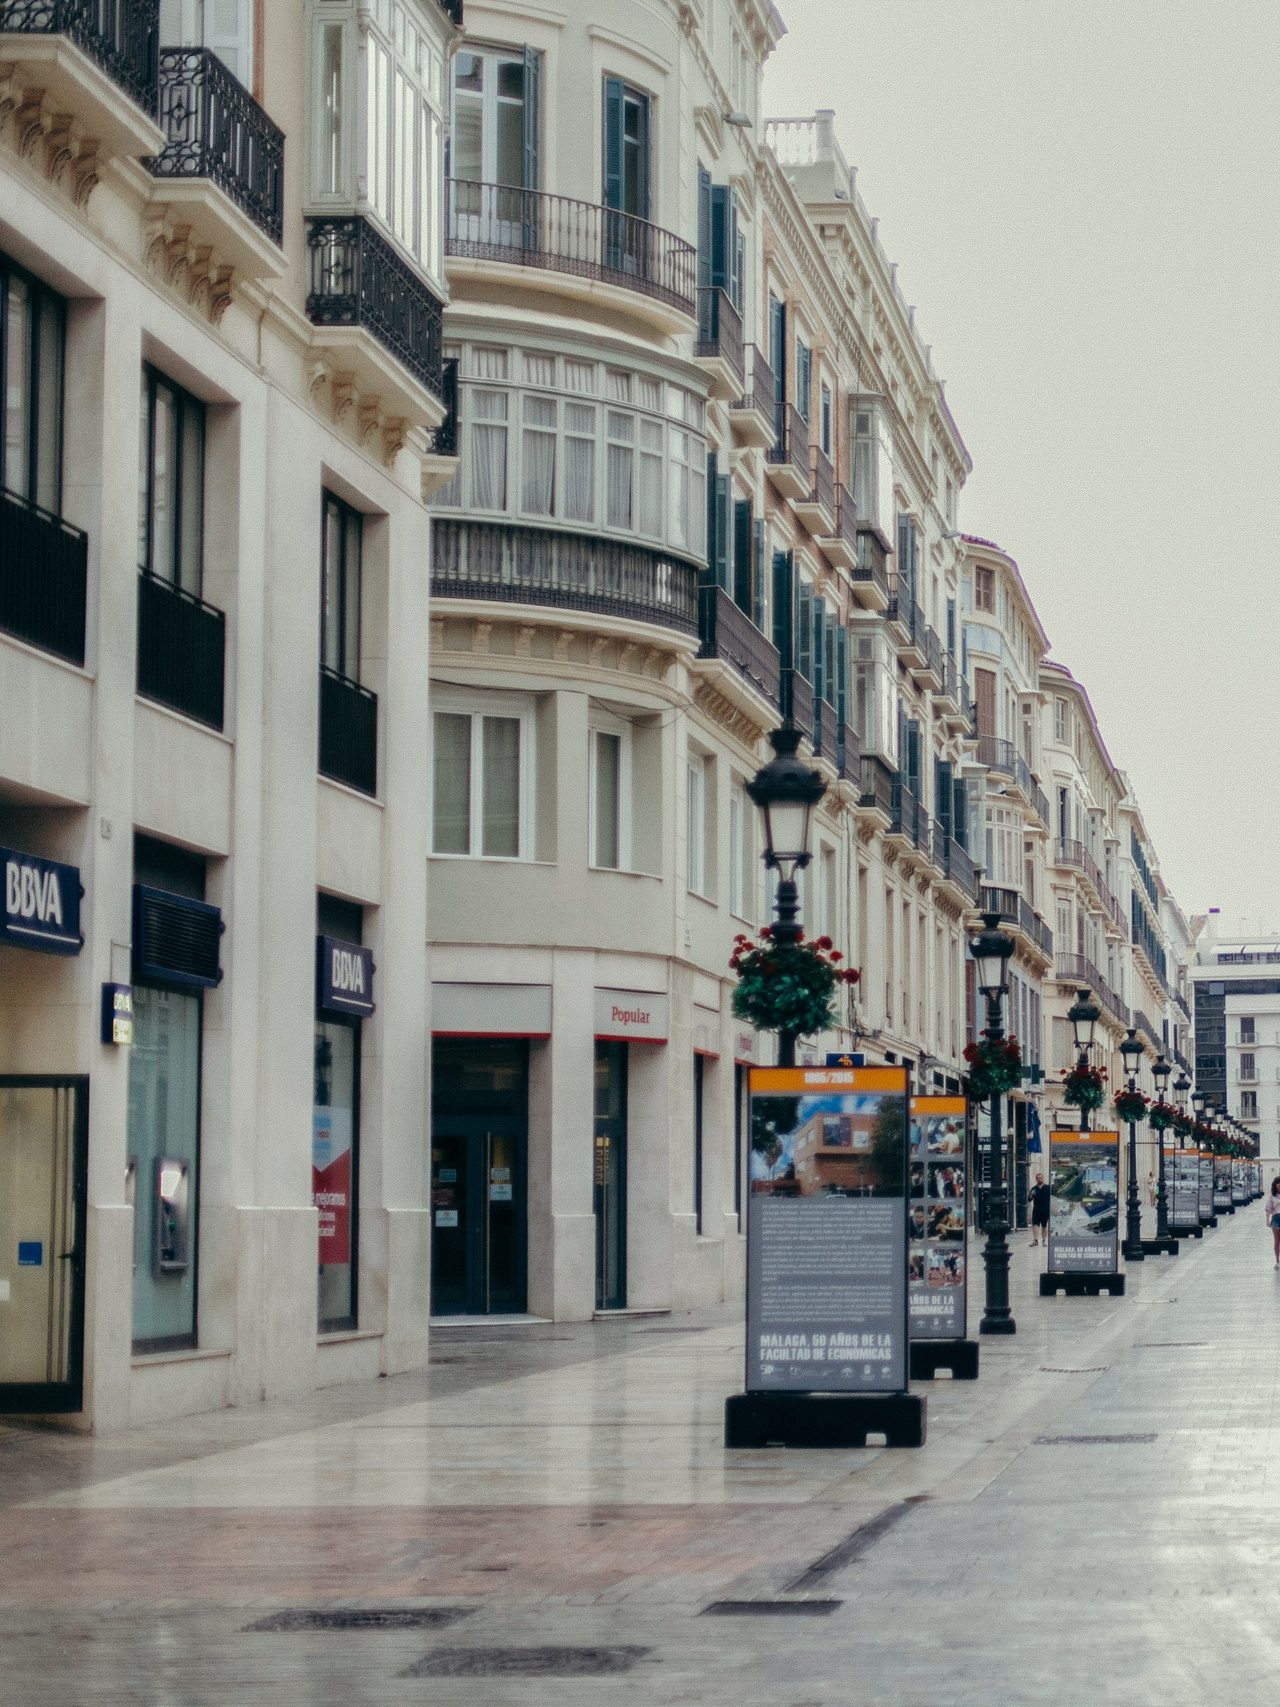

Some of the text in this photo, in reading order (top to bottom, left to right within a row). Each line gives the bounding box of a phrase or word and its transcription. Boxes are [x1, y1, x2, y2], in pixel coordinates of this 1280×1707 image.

[6, 861, 62, 926] BBVA
[331, 948, 364, 994] BBVA
[611, 1005, 650, 1026] Popular
[760, 1332, 891, 1348] MÁLAGA, 50 AÑOS DE LA
[760, 1346, 892, 1361] FACULTAD DE ECONÓMICAS
